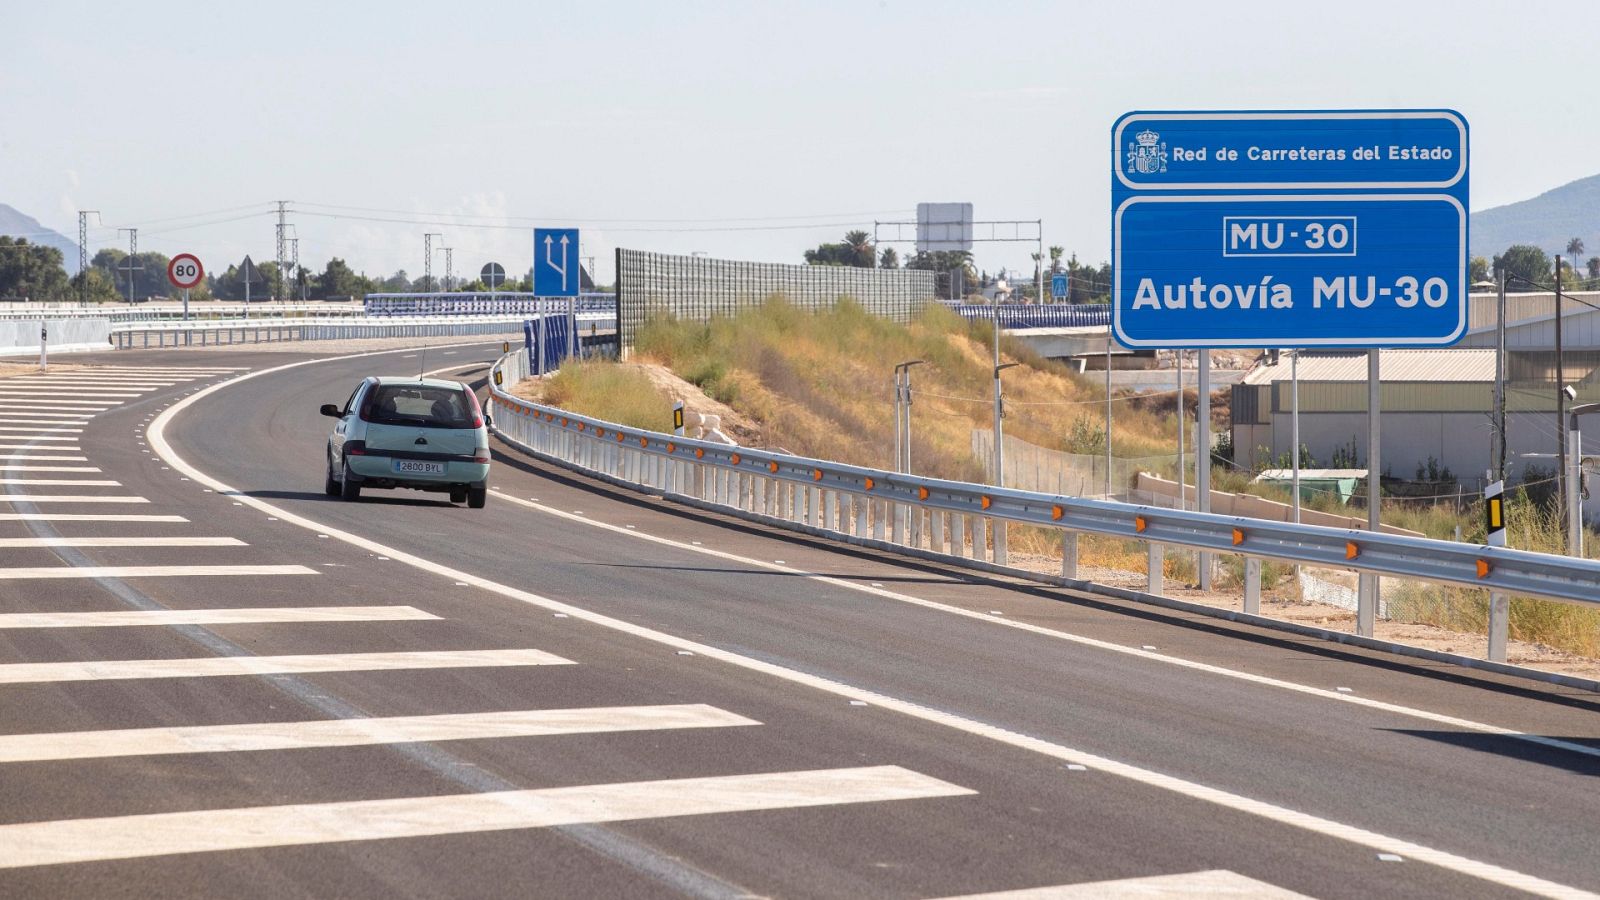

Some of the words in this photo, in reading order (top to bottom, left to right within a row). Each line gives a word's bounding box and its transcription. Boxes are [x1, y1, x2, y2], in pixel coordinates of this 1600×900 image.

[1173, 147, 1207, 161] Red
[1215, 147, 1238, 161] de
[1247, 146, 1346, 161] Carreteras
[1352, 146, 1381, 161] del
[1388, 145, 1452, 160] Estado
[1231, 223, 1349, 249] MU-30
[176, 265, 196, 276] 80
[1132, 275, 1294, 310] Autovía
[1313, 275, 1449, 308] MU-30
[402, 462, 423, 471] 2800
